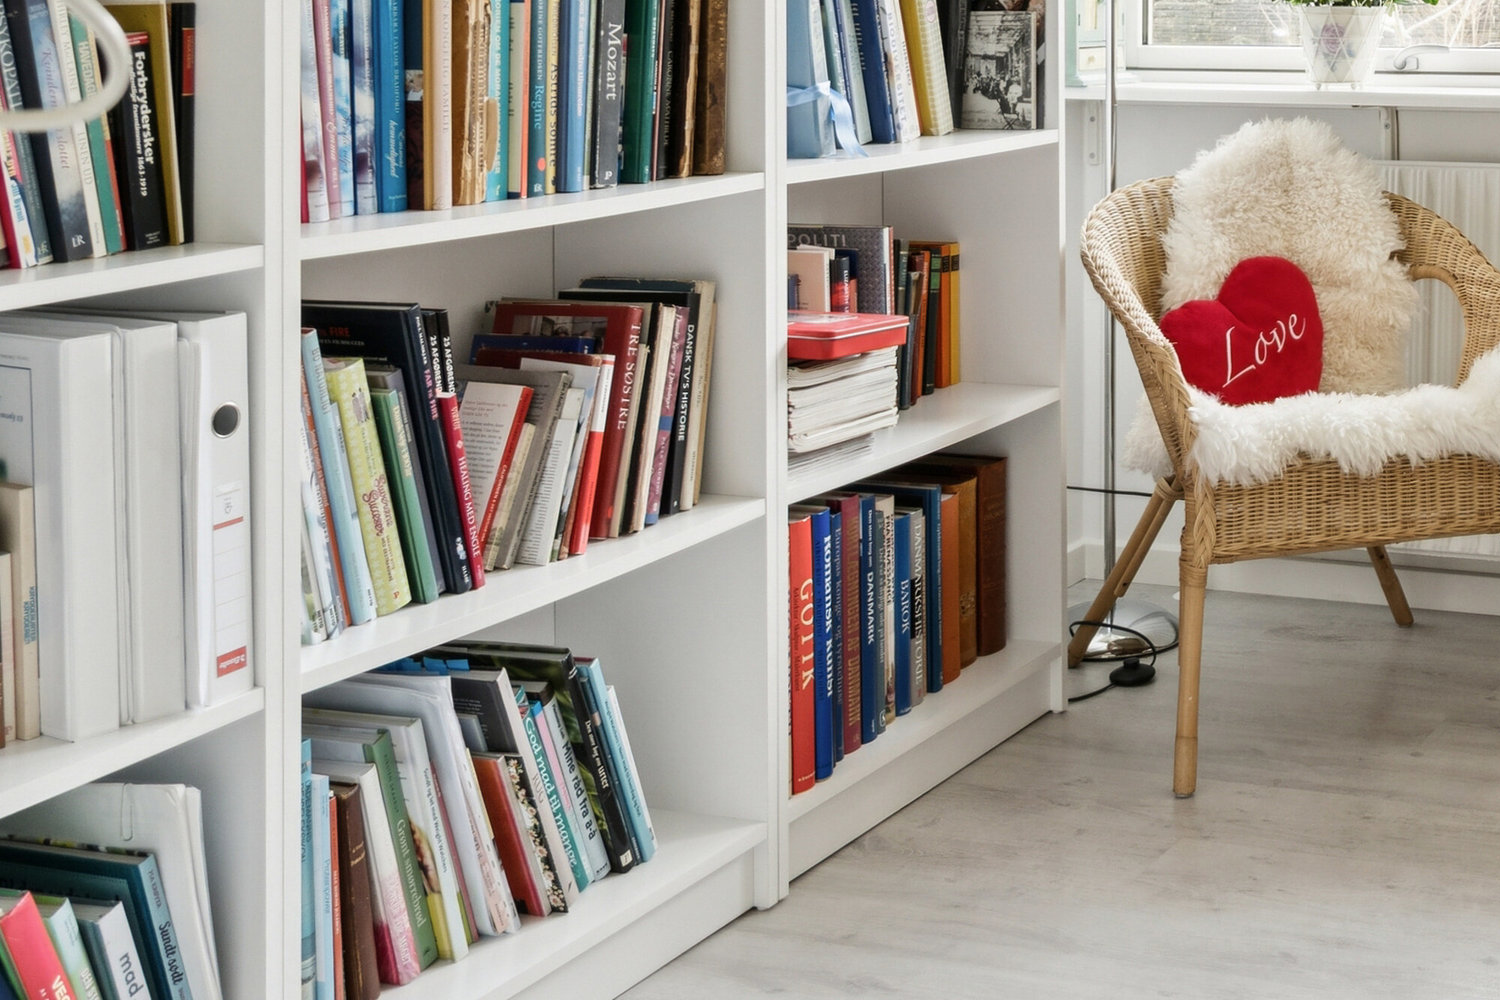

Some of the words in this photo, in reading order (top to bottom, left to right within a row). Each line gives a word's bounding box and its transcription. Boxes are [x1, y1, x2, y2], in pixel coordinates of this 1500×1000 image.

[605, 22, 622, 101] Mozart
[134, 51, 156, 165] Forbrydersker
[532, 85, 546, 130] Regine
[138, 155, 149, 197] 1863-1919
[626, 321, 643, 357] TRE
[684, 323, 696, 362] DANSK
[1222, 312, 1306, 389] Love
[616, 361, 638, 432] SØSTRE
[682, 366, 692, 389] TV'S
[677, 391, 689, 442] HISTORIE
[457, 456, 472, 501] HEALING
[463, 502, 475, 525] MED
[467, 527, 482, 558] ENGLE
[866, 571, 876, 645] DANMARK
[900, 579, 911, 634] BAROK
[914, 523, 924, 684] DANMARKSHISTORIE
[800, 577, 815, 691] GOTIK
[524, 716, 543, 755] God
[535, 755, 554, 795] mad
[561, 741, 576, 774] Mine
[572, 776, 587, 799] råd
[580, 800, 592, 819] fra
[543, 794, 562, 813] til
[395, 818, 411, 858] Grønt
[551, 814, 579, 869] mange
[159, 920, 178, 959] Sundt
[119, 953, 144, 998] mad
